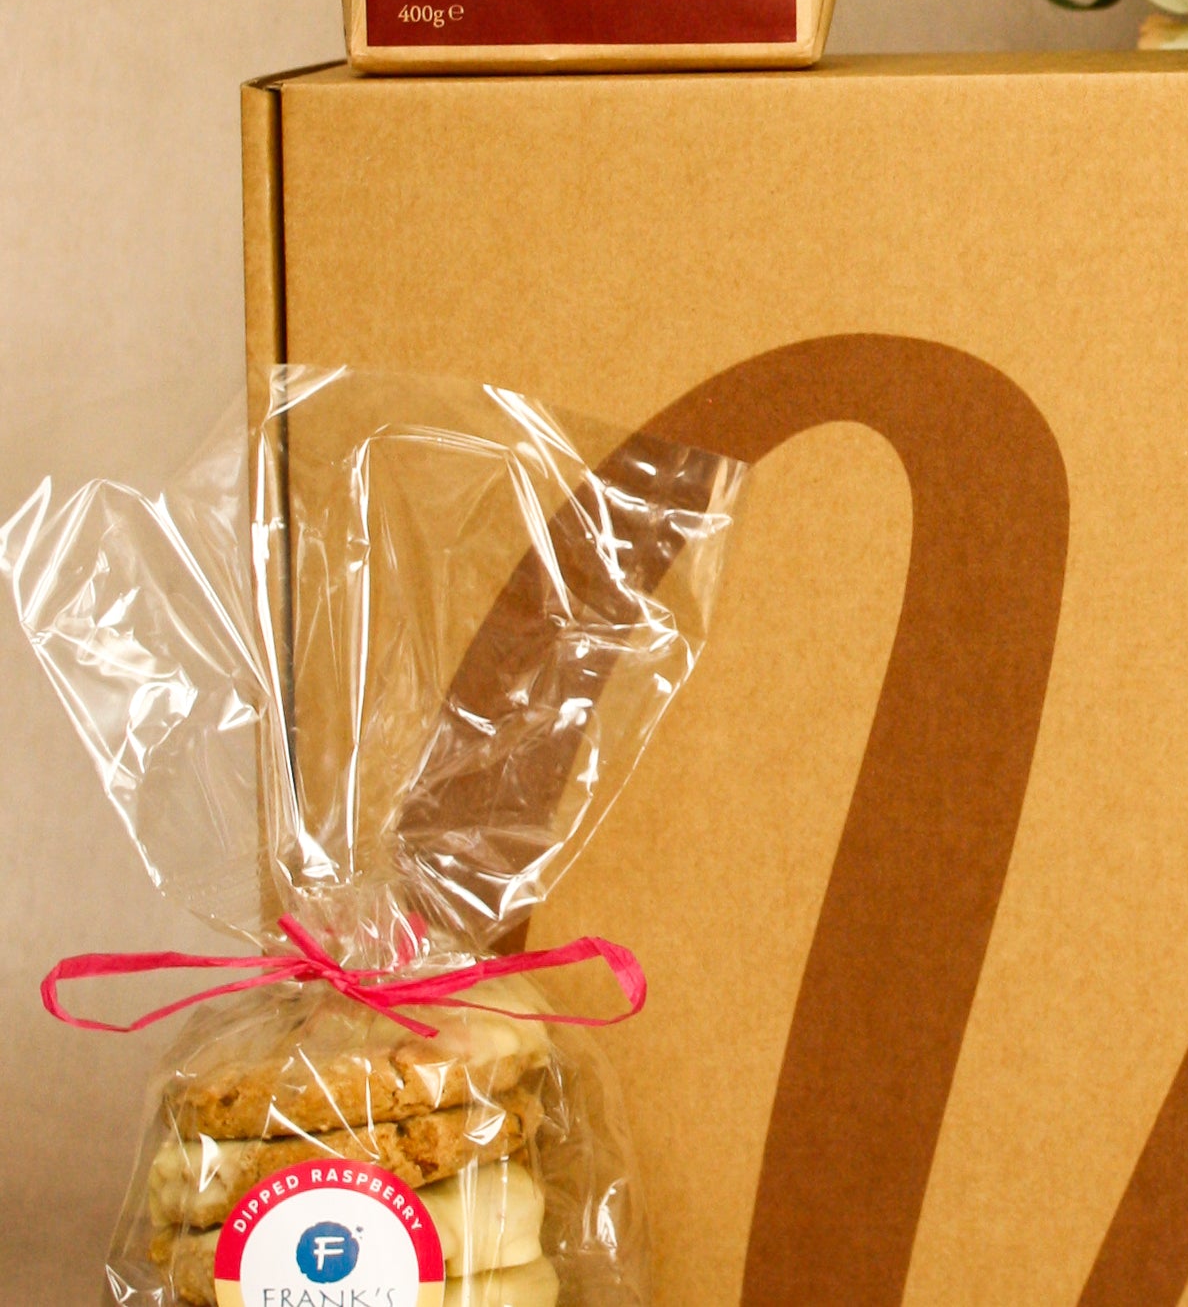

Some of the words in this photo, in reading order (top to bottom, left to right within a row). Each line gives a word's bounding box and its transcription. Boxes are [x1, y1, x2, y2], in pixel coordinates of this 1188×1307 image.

[398, 4, 445, 27] 400g
[233, 1174, 300, 1234] DIPPED
[310, 1167, 424, 1231] RASPBERRY
[313, 1236, 345, 1271] F
[262, 1286, 397, 1307] FRANK'S
